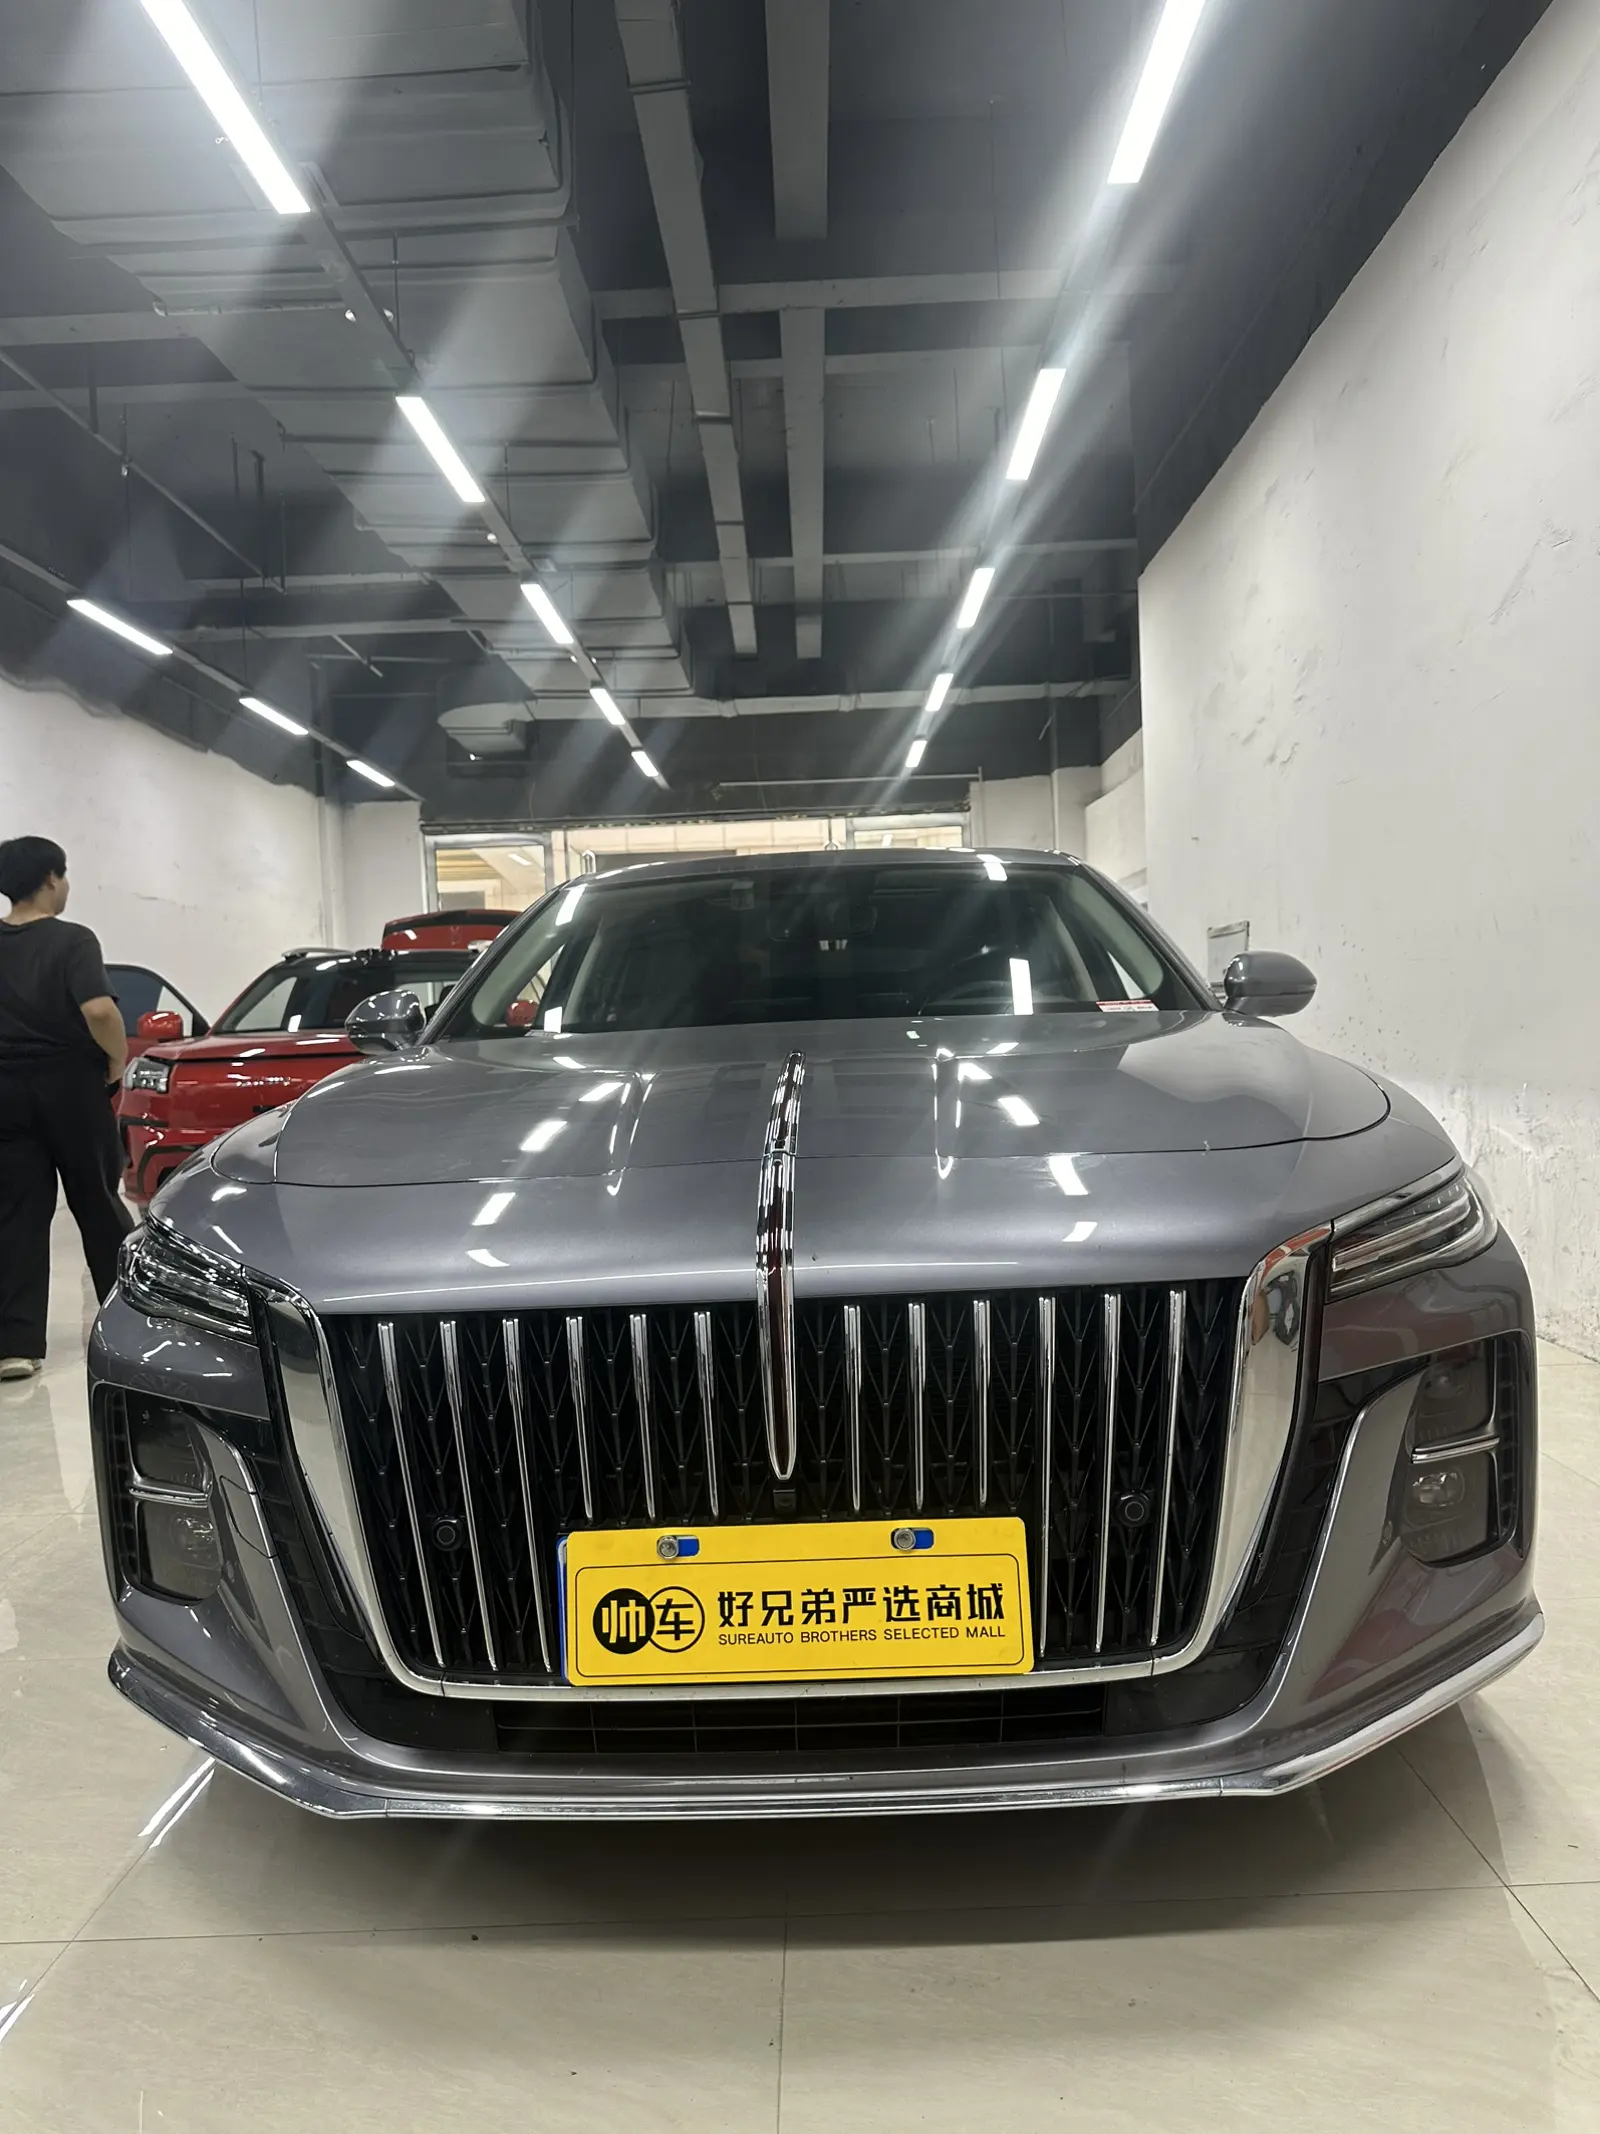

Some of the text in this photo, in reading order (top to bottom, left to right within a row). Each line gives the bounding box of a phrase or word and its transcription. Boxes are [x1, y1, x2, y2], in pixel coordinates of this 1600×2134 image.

[718, 1583, 1004, 1628] 好兄弟严选商城
[718, 1625, 1006, 1646] SUREAUTO BROTHERS SELECTED MALL
